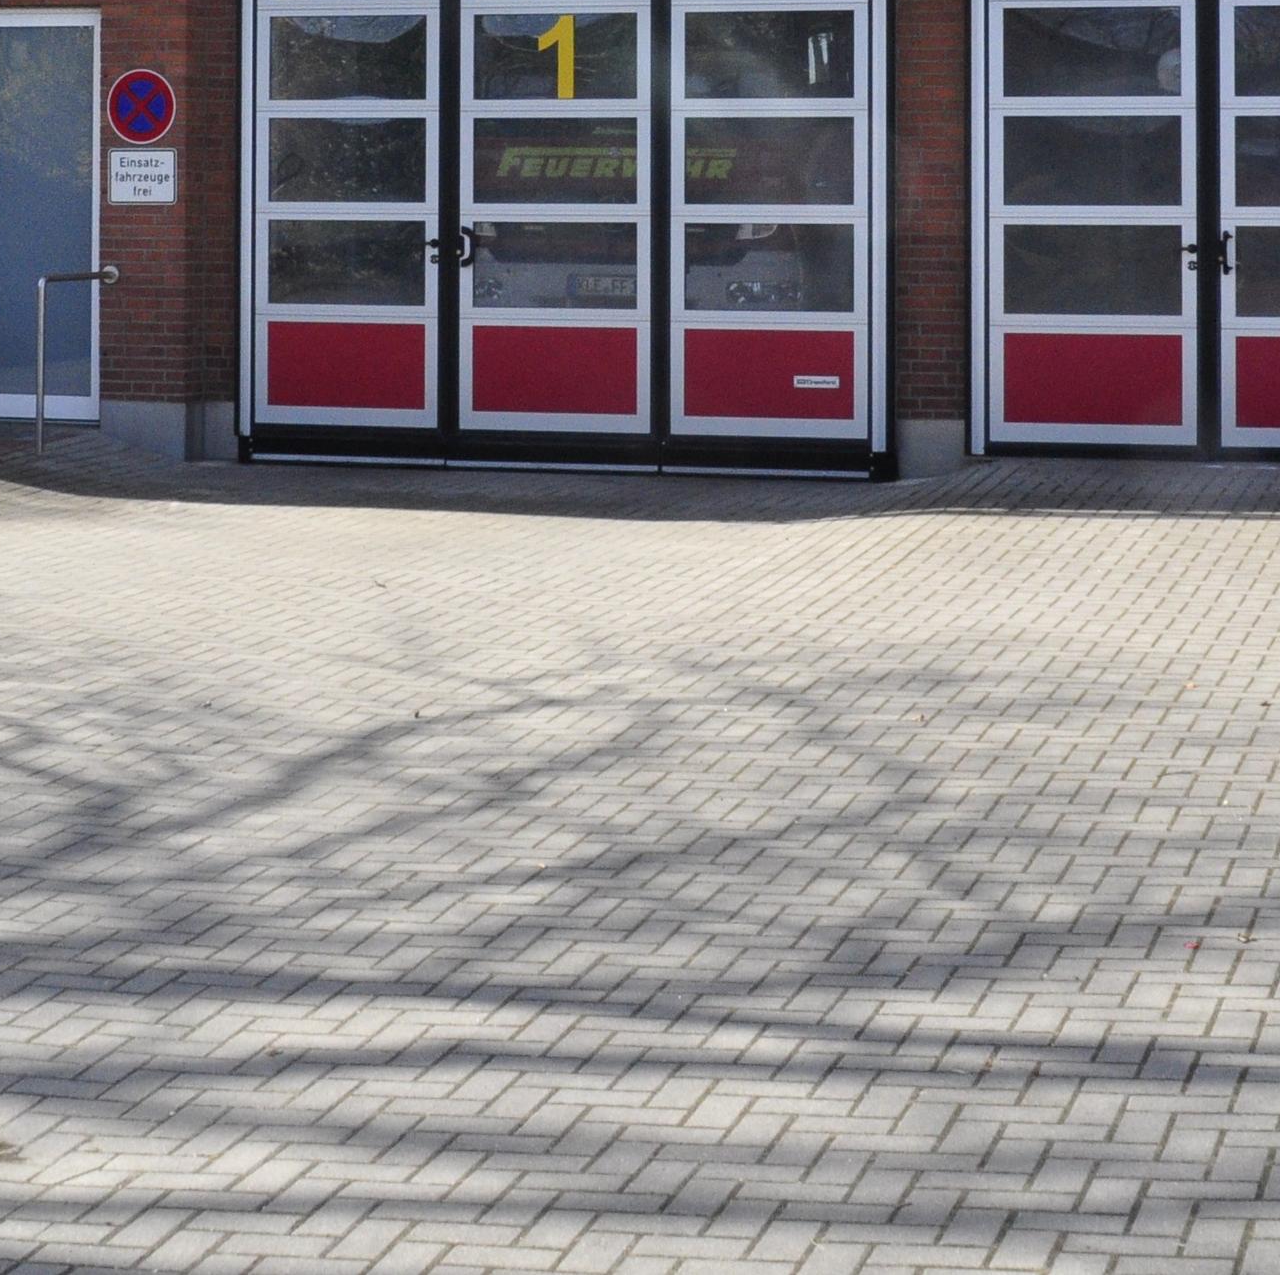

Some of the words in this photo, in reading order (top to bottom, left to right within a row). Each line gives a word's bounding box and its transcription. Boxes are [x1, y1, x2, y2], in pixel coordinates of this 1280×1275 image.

[537, 14, 575, 99] 1
[119, 156, 165, 168] Einsatz-
[496, 146, 737, 179] FEUERHR
[115, 171, 171, 185] fahrzeuge
[133, 186, 153, 197] frei
